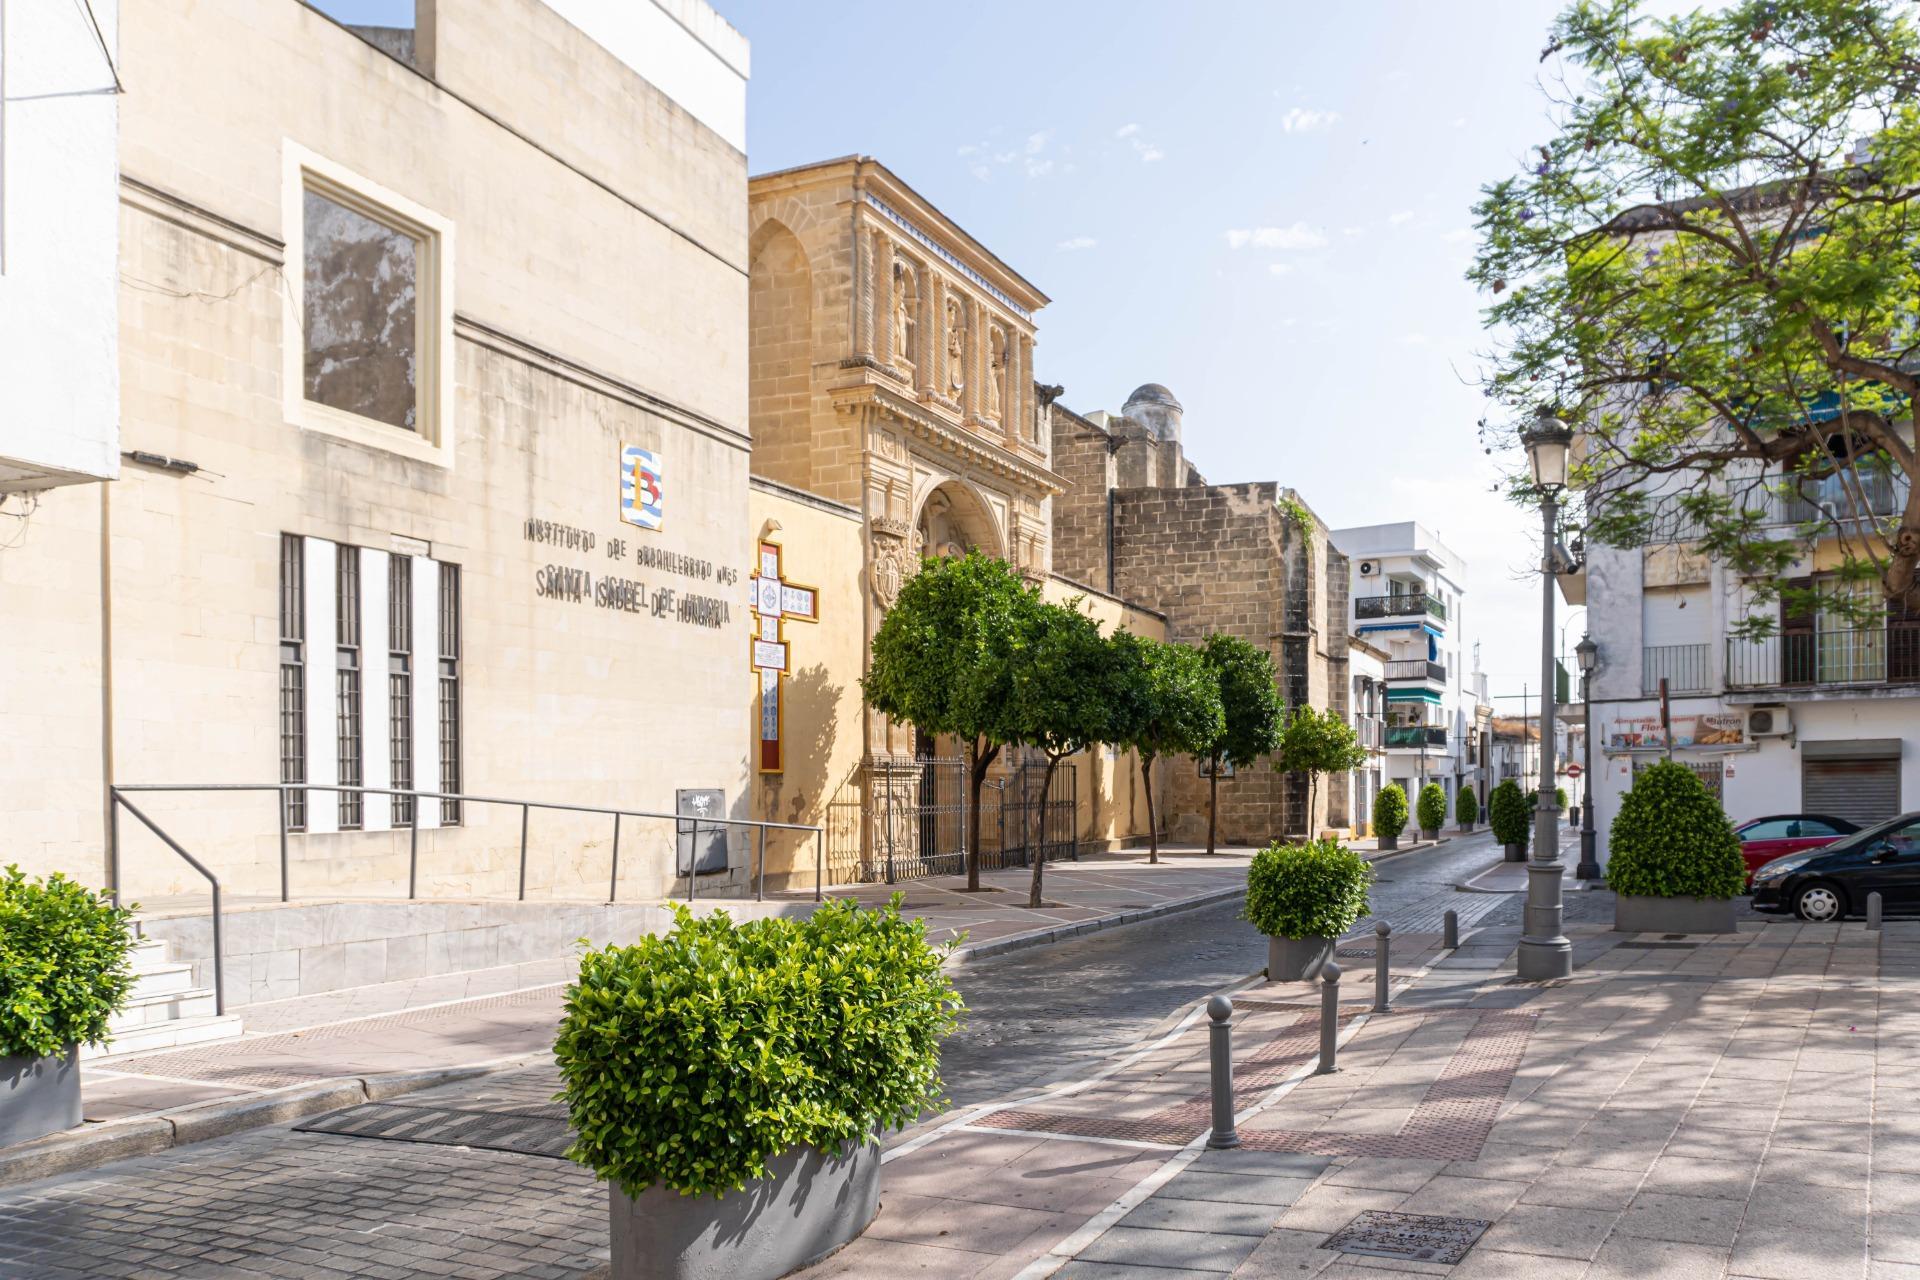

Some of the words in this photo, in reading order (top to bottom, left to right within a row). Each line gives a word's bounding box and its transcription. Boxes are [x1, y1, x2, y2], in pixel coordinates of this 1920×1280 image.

[523, 516, 596, 553] INSTITUTO
[607, 537, 627, 561] DE
[637, 544, 712, 581] BACHILLERATO
[535, 563, 592, 604] SANTA
[595, 575, 649, 614] ISABEL
[651, 586, 676, 619] DE
